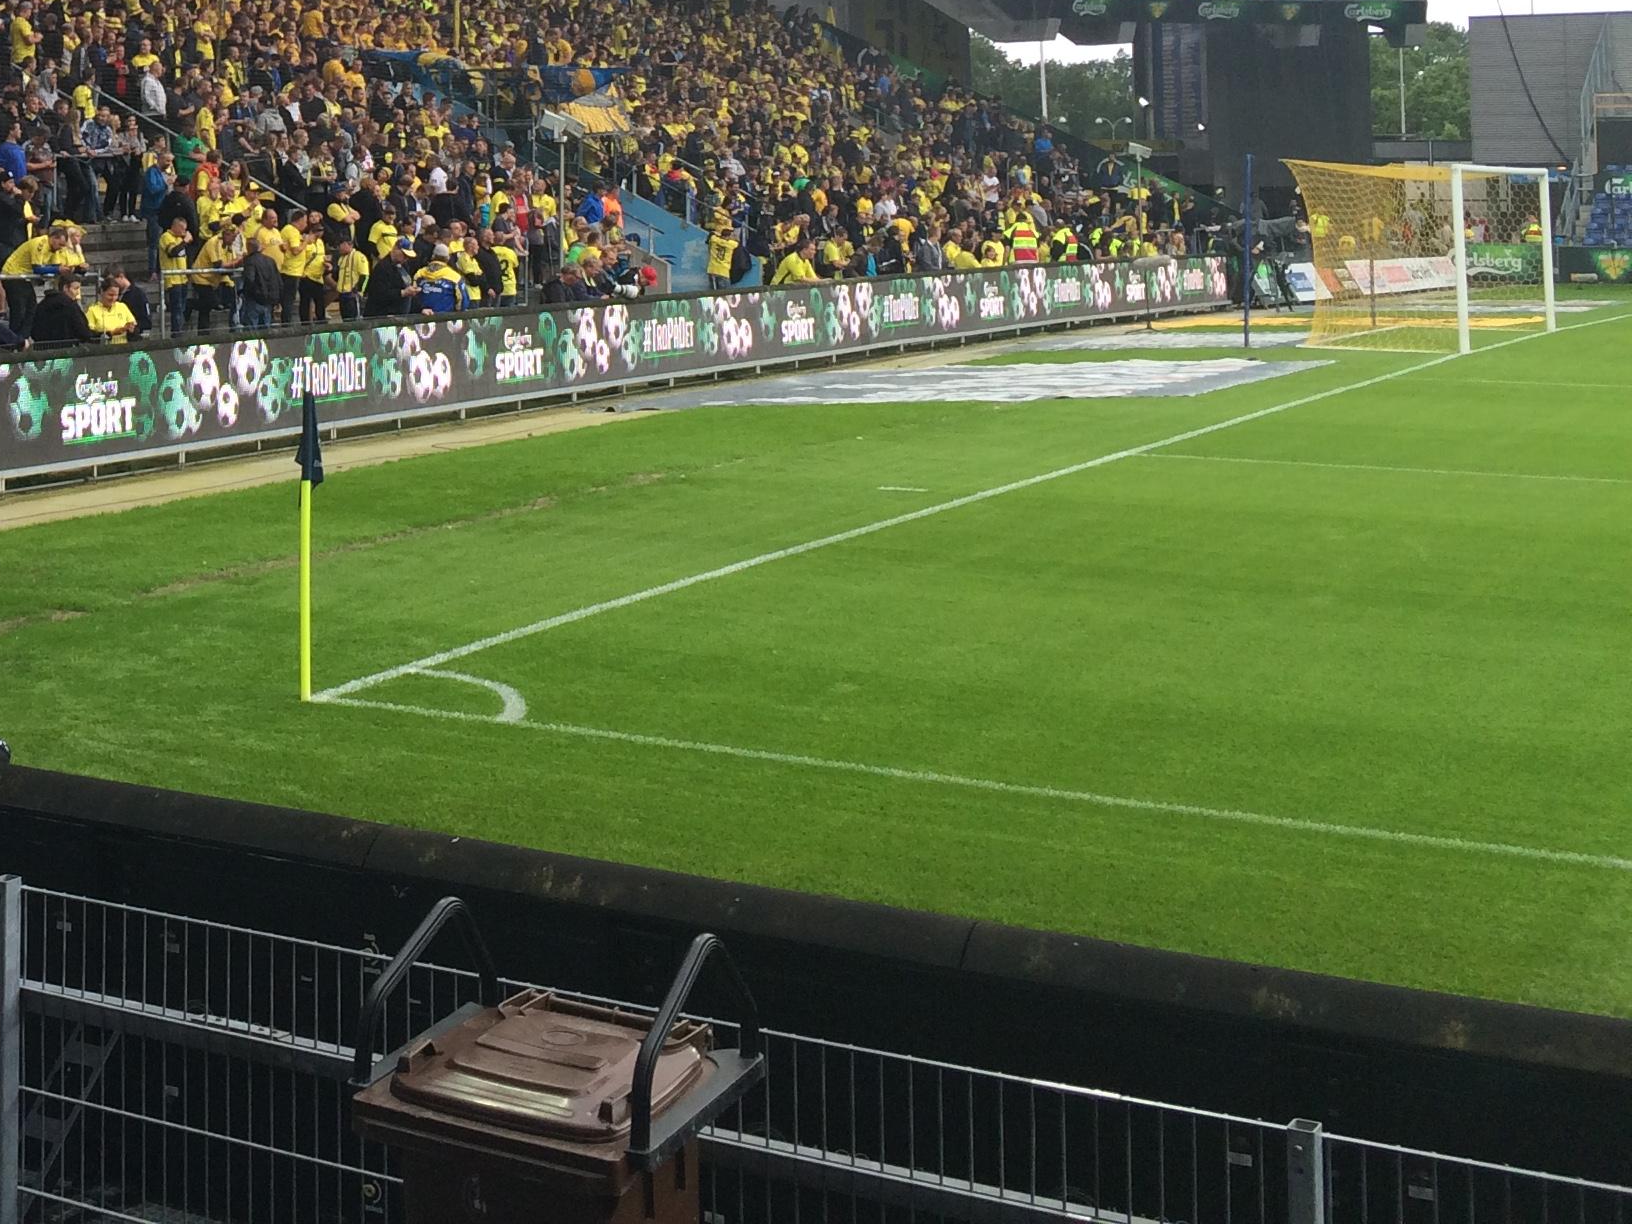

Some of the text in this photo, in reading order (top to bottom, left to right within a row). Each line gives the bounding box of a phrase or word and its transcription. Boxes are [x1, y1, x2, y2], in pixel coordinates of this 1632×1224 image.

[1198, 1, 1240, 19] Carlsberg
[1344, 3, 1393, 23] Carlsberg
[781, 317, 816, 344] SPORT
[496, 348, 544, 381] SPORT
[60, 397, 136, 440] SPORT
